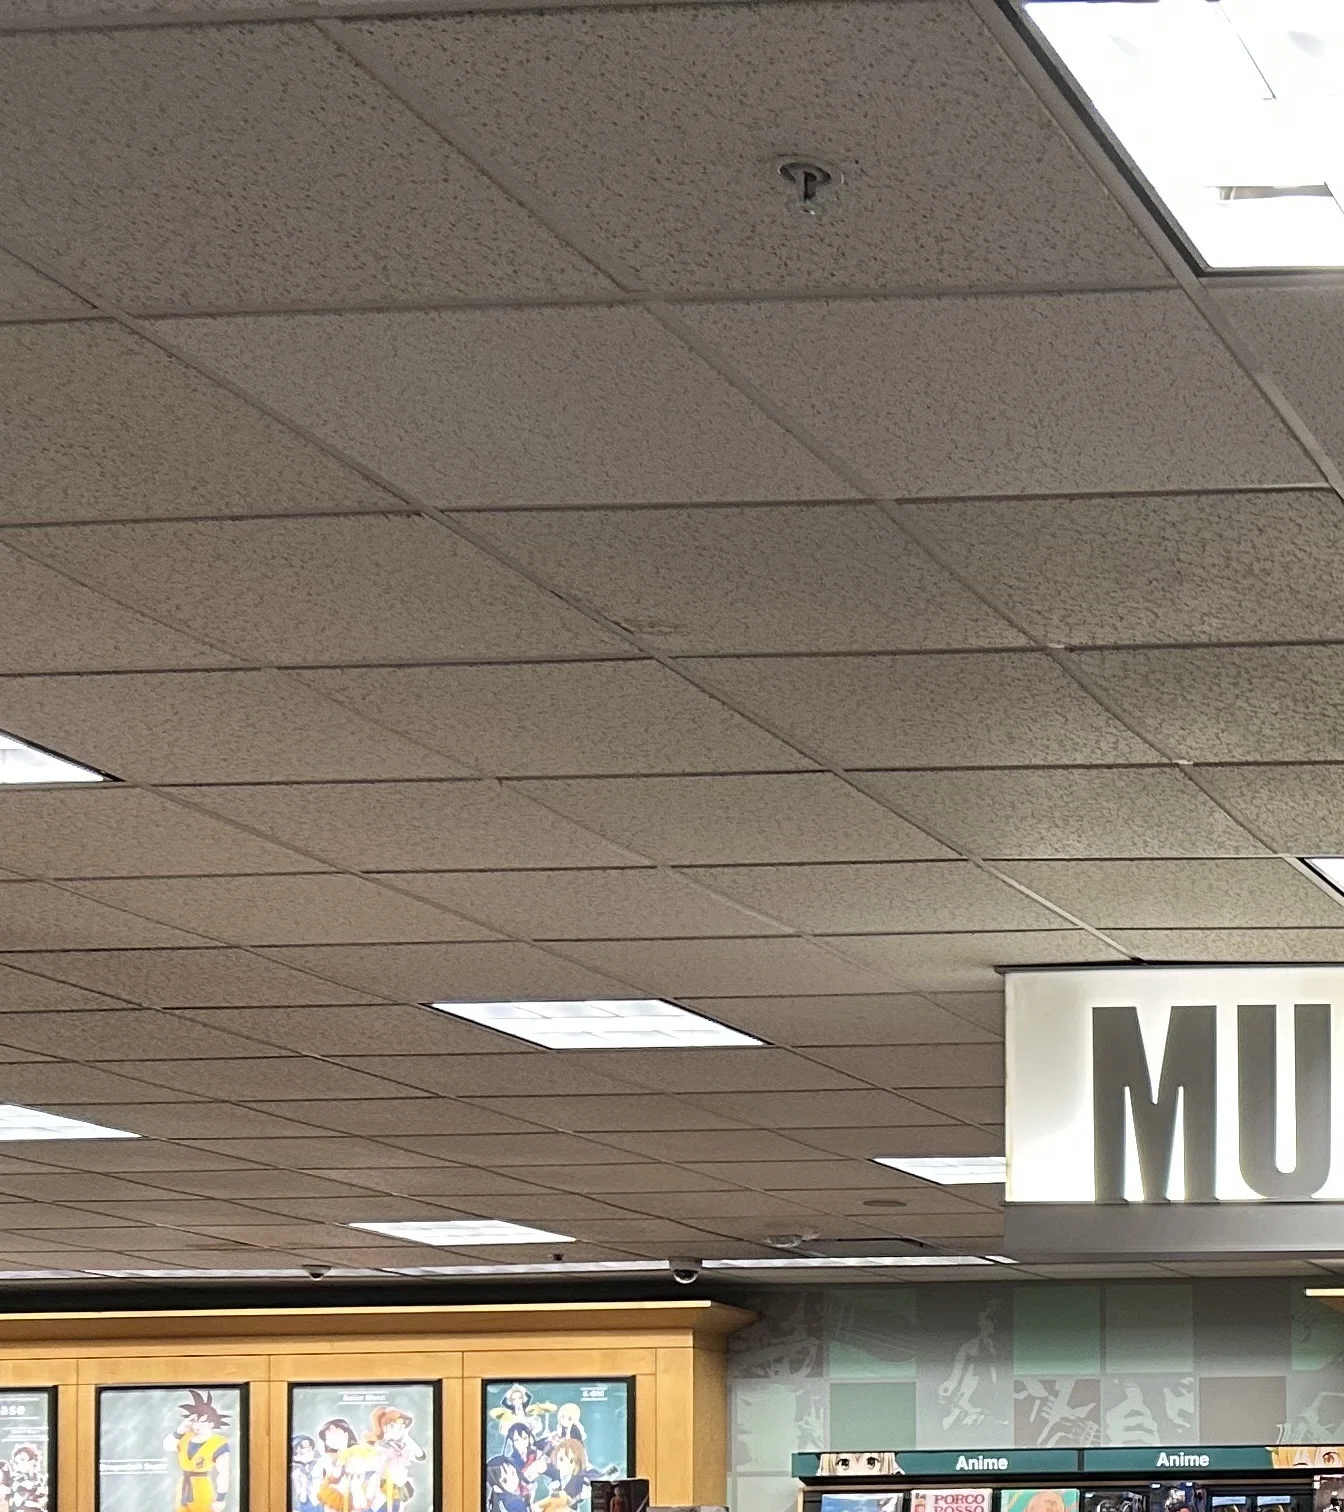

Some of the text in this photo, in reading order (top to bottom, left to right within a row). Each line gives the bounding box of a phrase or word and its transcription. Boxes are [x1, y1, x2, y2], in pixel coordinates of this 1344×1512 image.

[955, 1455, 1009, 1472] Anime
[1156, 1451, 1210, 1468] Anime
[933, 1493, 985, 1505] PORCO
